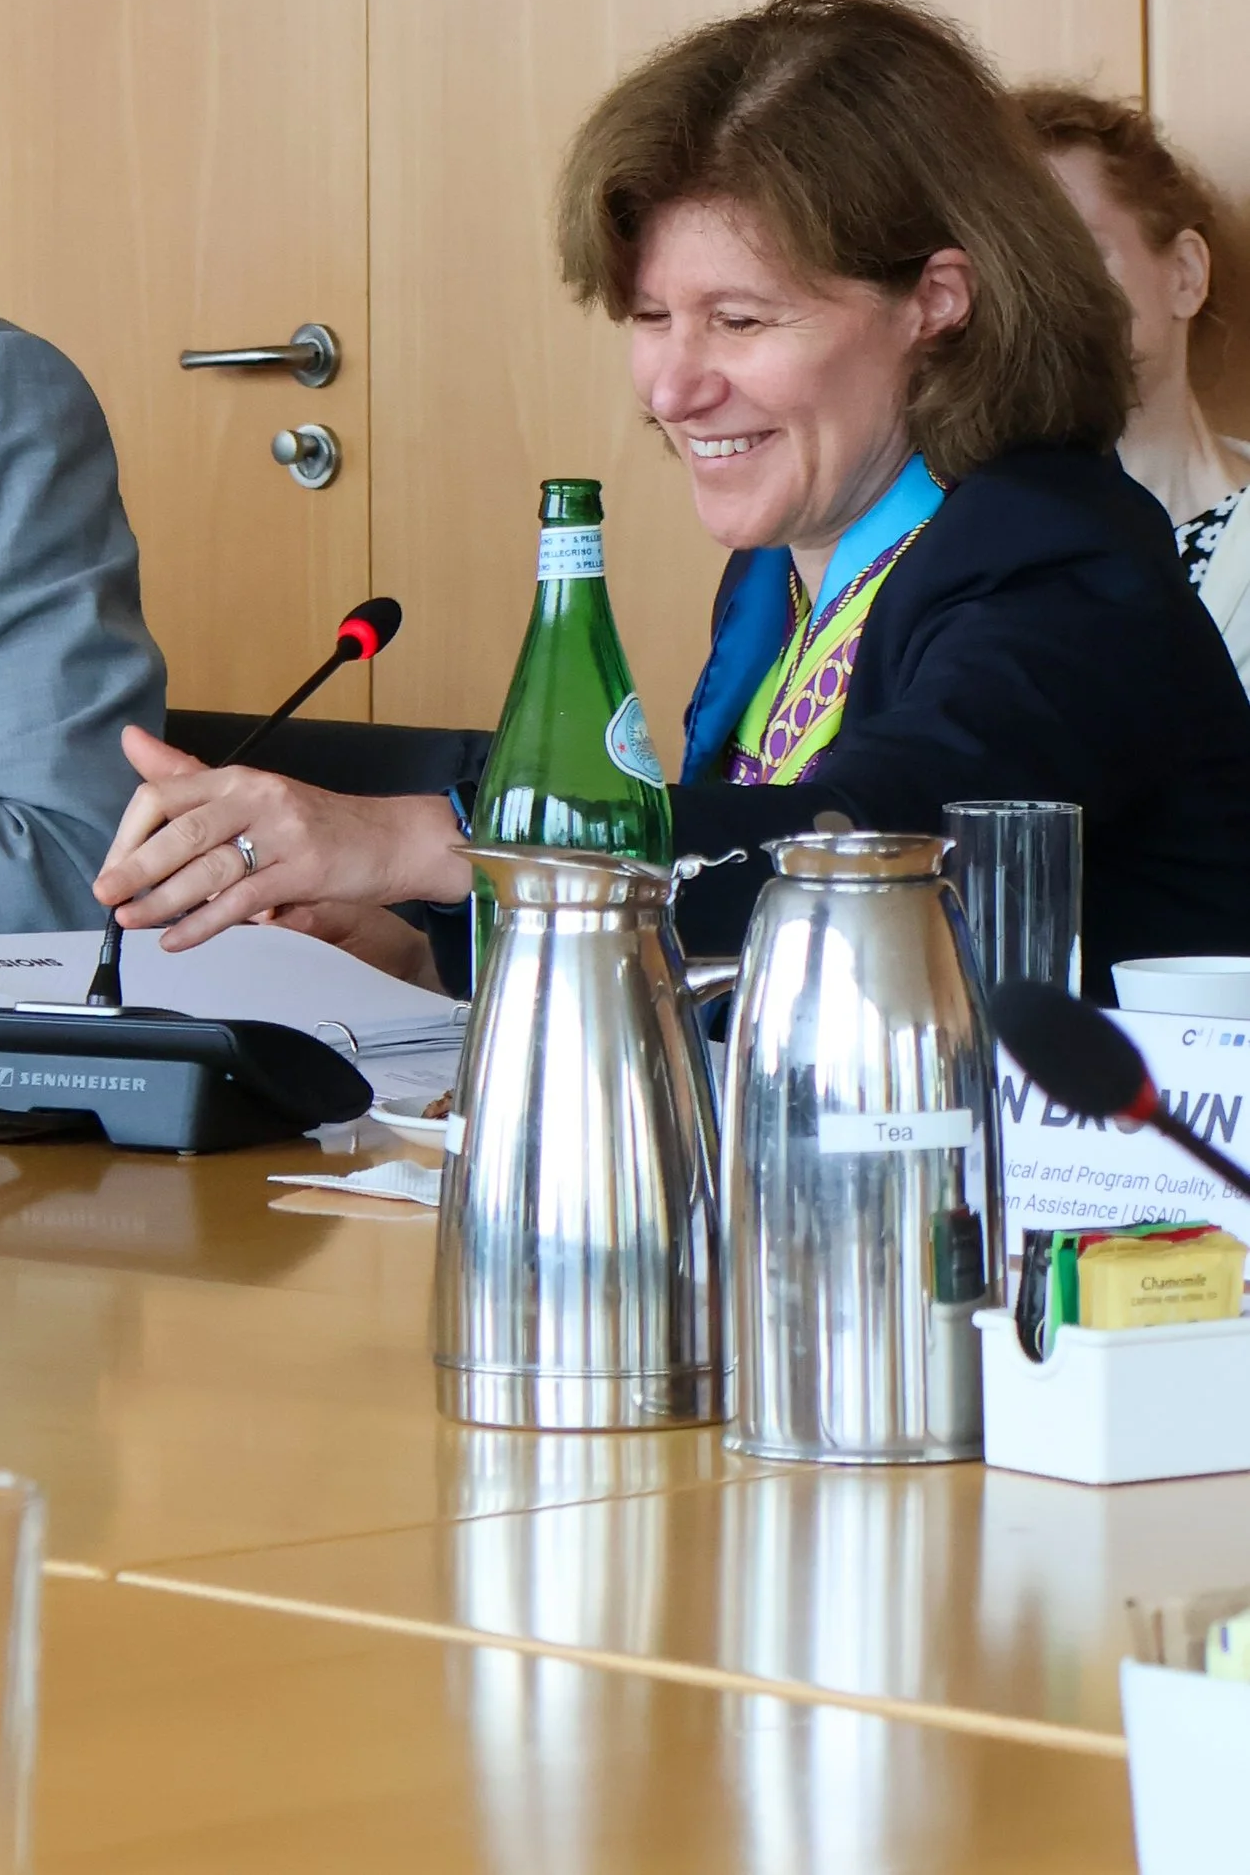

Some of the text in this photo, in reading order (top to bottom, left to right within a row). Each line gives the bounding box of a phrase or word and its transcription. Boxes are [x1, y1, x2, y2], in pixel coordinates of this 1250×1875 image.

[19, 1071, 147, 1092] SENNHEISER
[1040, 1085, 1243, 1144] BWN
[873, 1122, 913, 1142] Tea
[1040, 1165, 1074, 1183] and
[1076, 1166, 1150, 1191] Program
[1154, 1173, 1216, 1202] Quality,
[1023, 1193, 1118, 1220] Assistance
[1132, 1204, 1187, 1224] USAID
